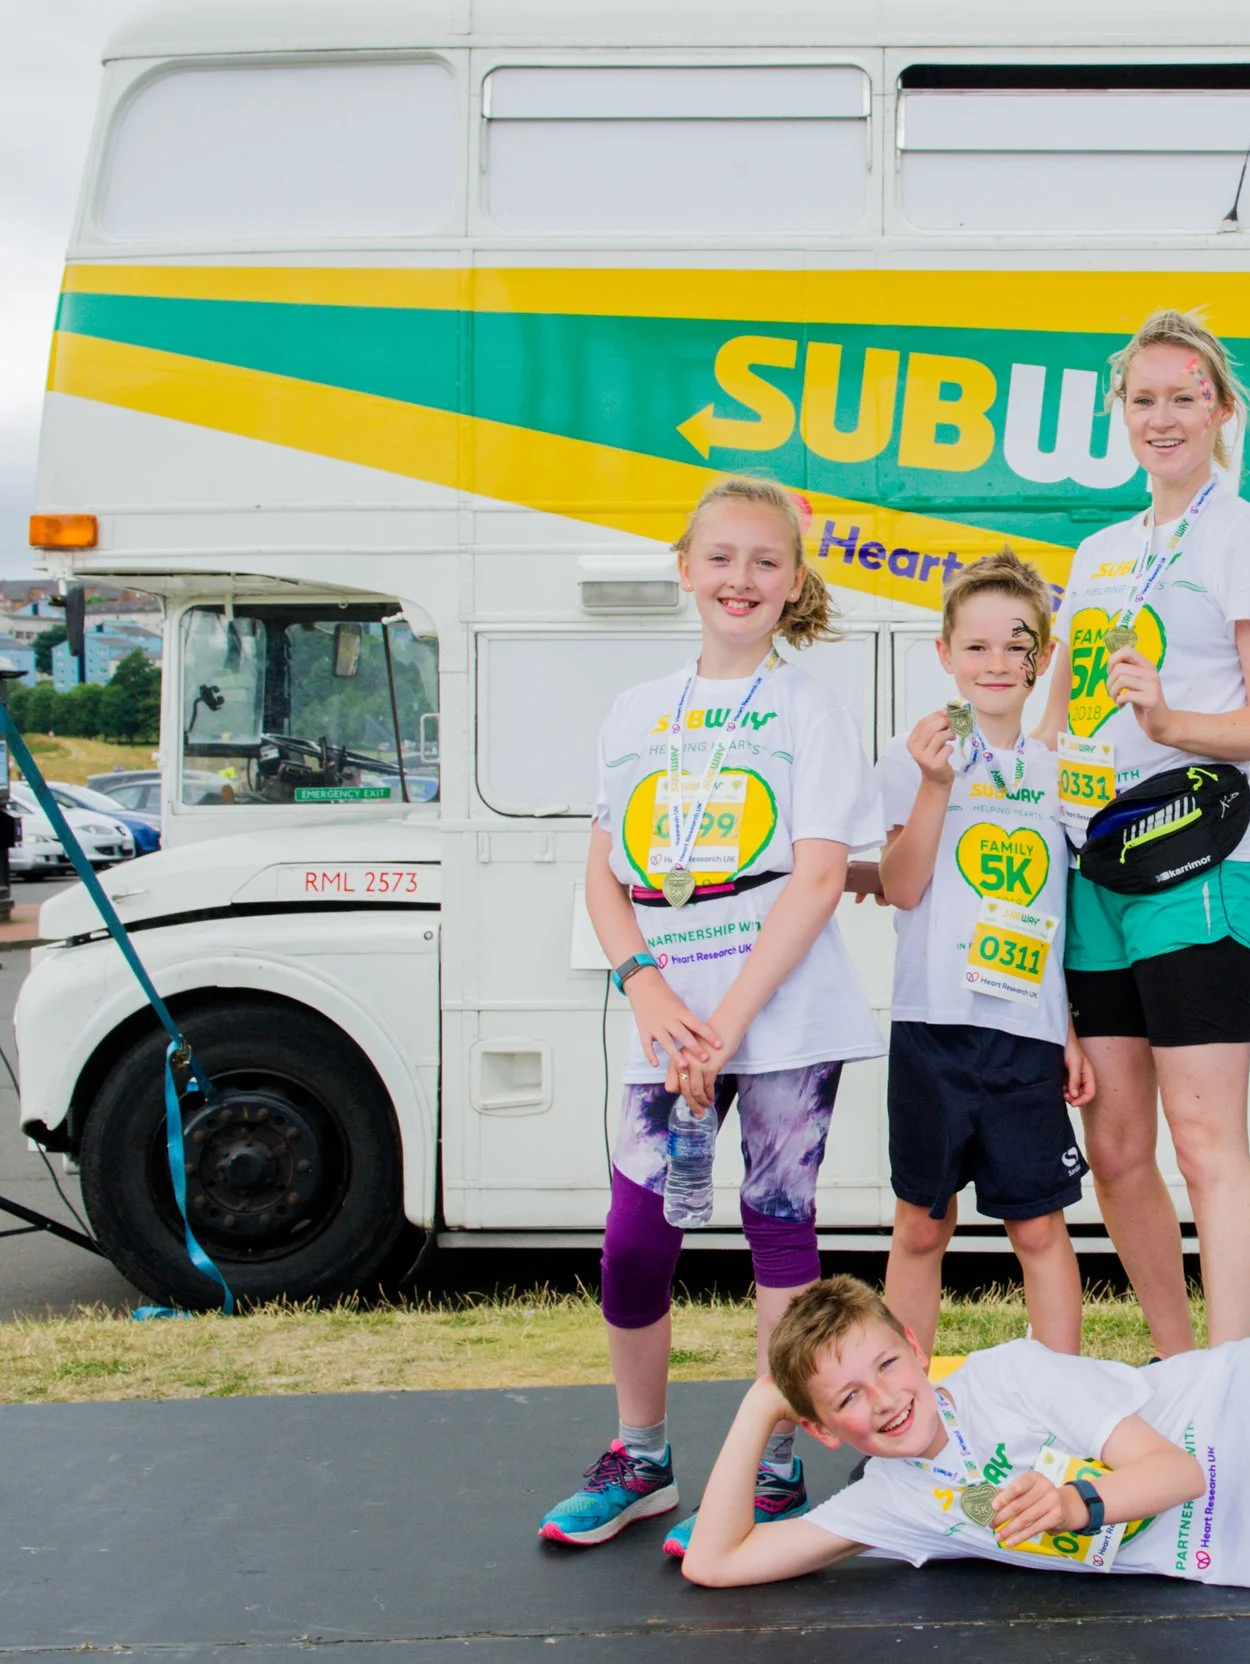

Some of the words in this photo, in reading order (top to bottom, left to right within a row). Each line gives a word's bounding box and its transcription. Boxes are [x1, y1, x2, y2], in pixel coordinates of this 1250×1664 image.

[817, 519, 965, 584] Heart
[1073, 629, 1106, 646] FAM
[650, 708, 778, 734] SBWY
[1072, 705, 1102, 722] 2018
[649, 742, 706, 755] HEING
[711, 740, 761, 755] ARTS
[1061, 769, 1111, 801] 0331
[1117, 769, 1140, 783] ITH
[301, 789, 361, 799] EMERGENCY
[363, 788, 386, 798] EXIT
[656, 812, 736, 839] 099
[723, 854, 736, 862] UK
[980, 839, 1034, 856] FAMILY
[979, 853, 1033, 895] 5K
[1169, 855, 1211, 878] karrimor
[304, 871, 355, 892] RML
[364, 871, 419, 893] 2573
[738, 943, 753, 954] UK
[979, 935, 1041, 975] 0311
[980, 977, 1002, 990] Heart
[1002, 982, 1029, 997] Research
[1028, 990, 1039, 999] UK
[1207, 1445, 1216, 1463] UK
[1204, 1465, 1216, 1515] Research
[1175, 1500, 1194, 1571] PARTNER
[1200, 1519, 1213, 1548] Heart
[1099, 1535, 1112, 1556] Heart
